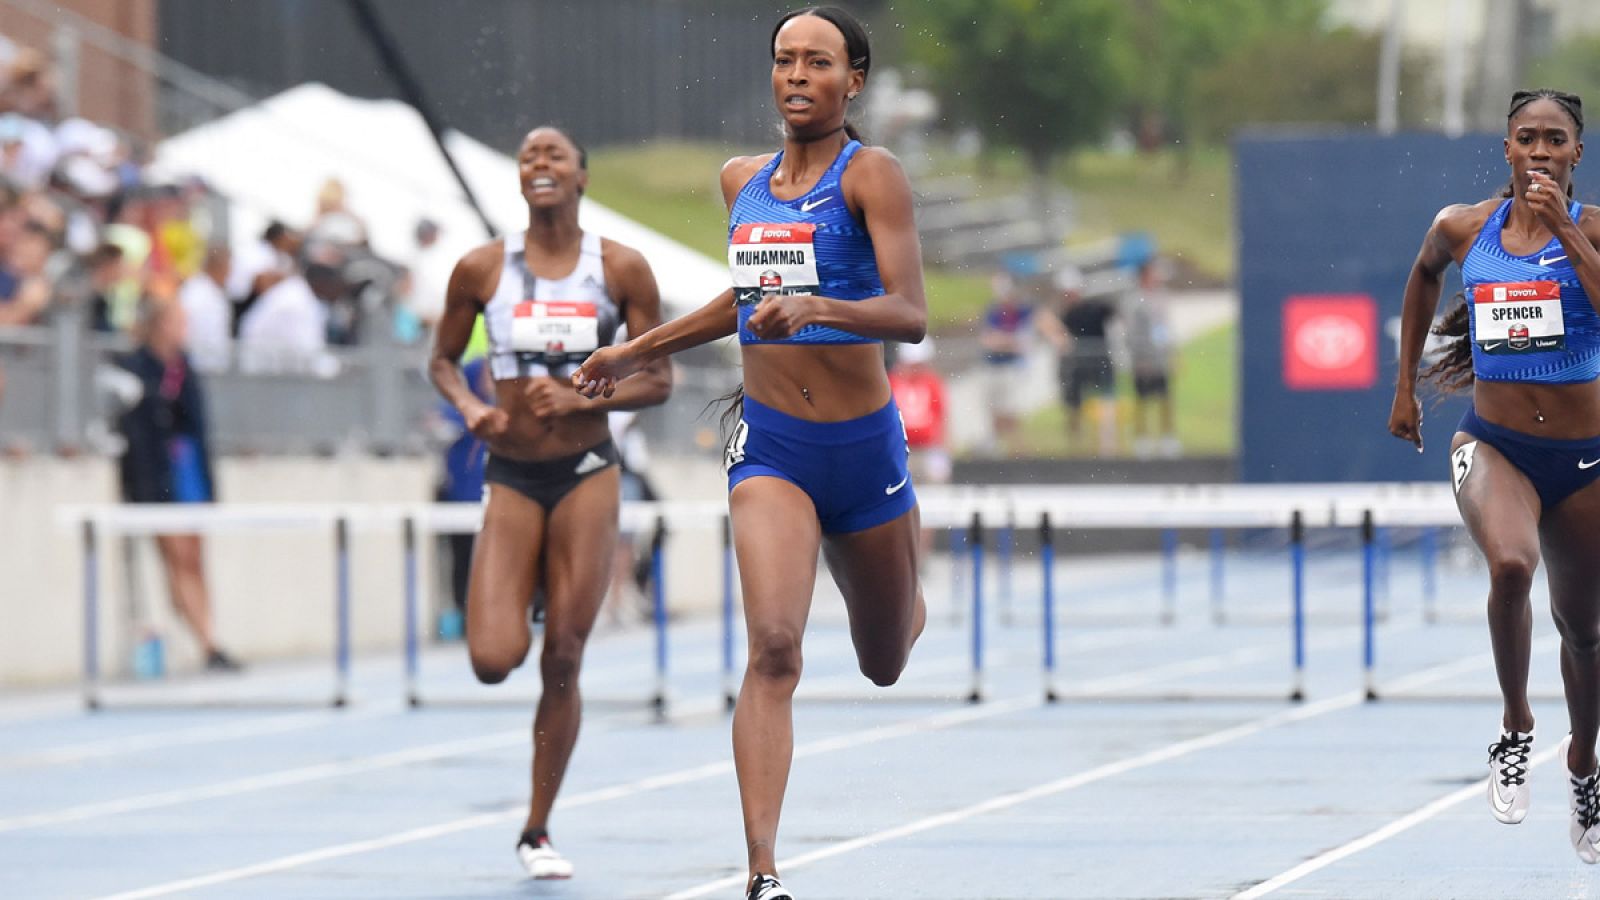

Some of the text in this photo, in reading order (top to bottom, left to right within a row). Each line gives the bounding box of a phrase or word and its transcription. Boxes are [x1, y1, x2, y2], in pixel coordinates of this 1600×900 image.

[763, 230, 791, 238] TOYOTA
[736, 250, 805, 265] MUHAMMAD
[1508, 289, 1538, 297] TOYOTA
[1491, 306, 1543, 320] SPENCER
